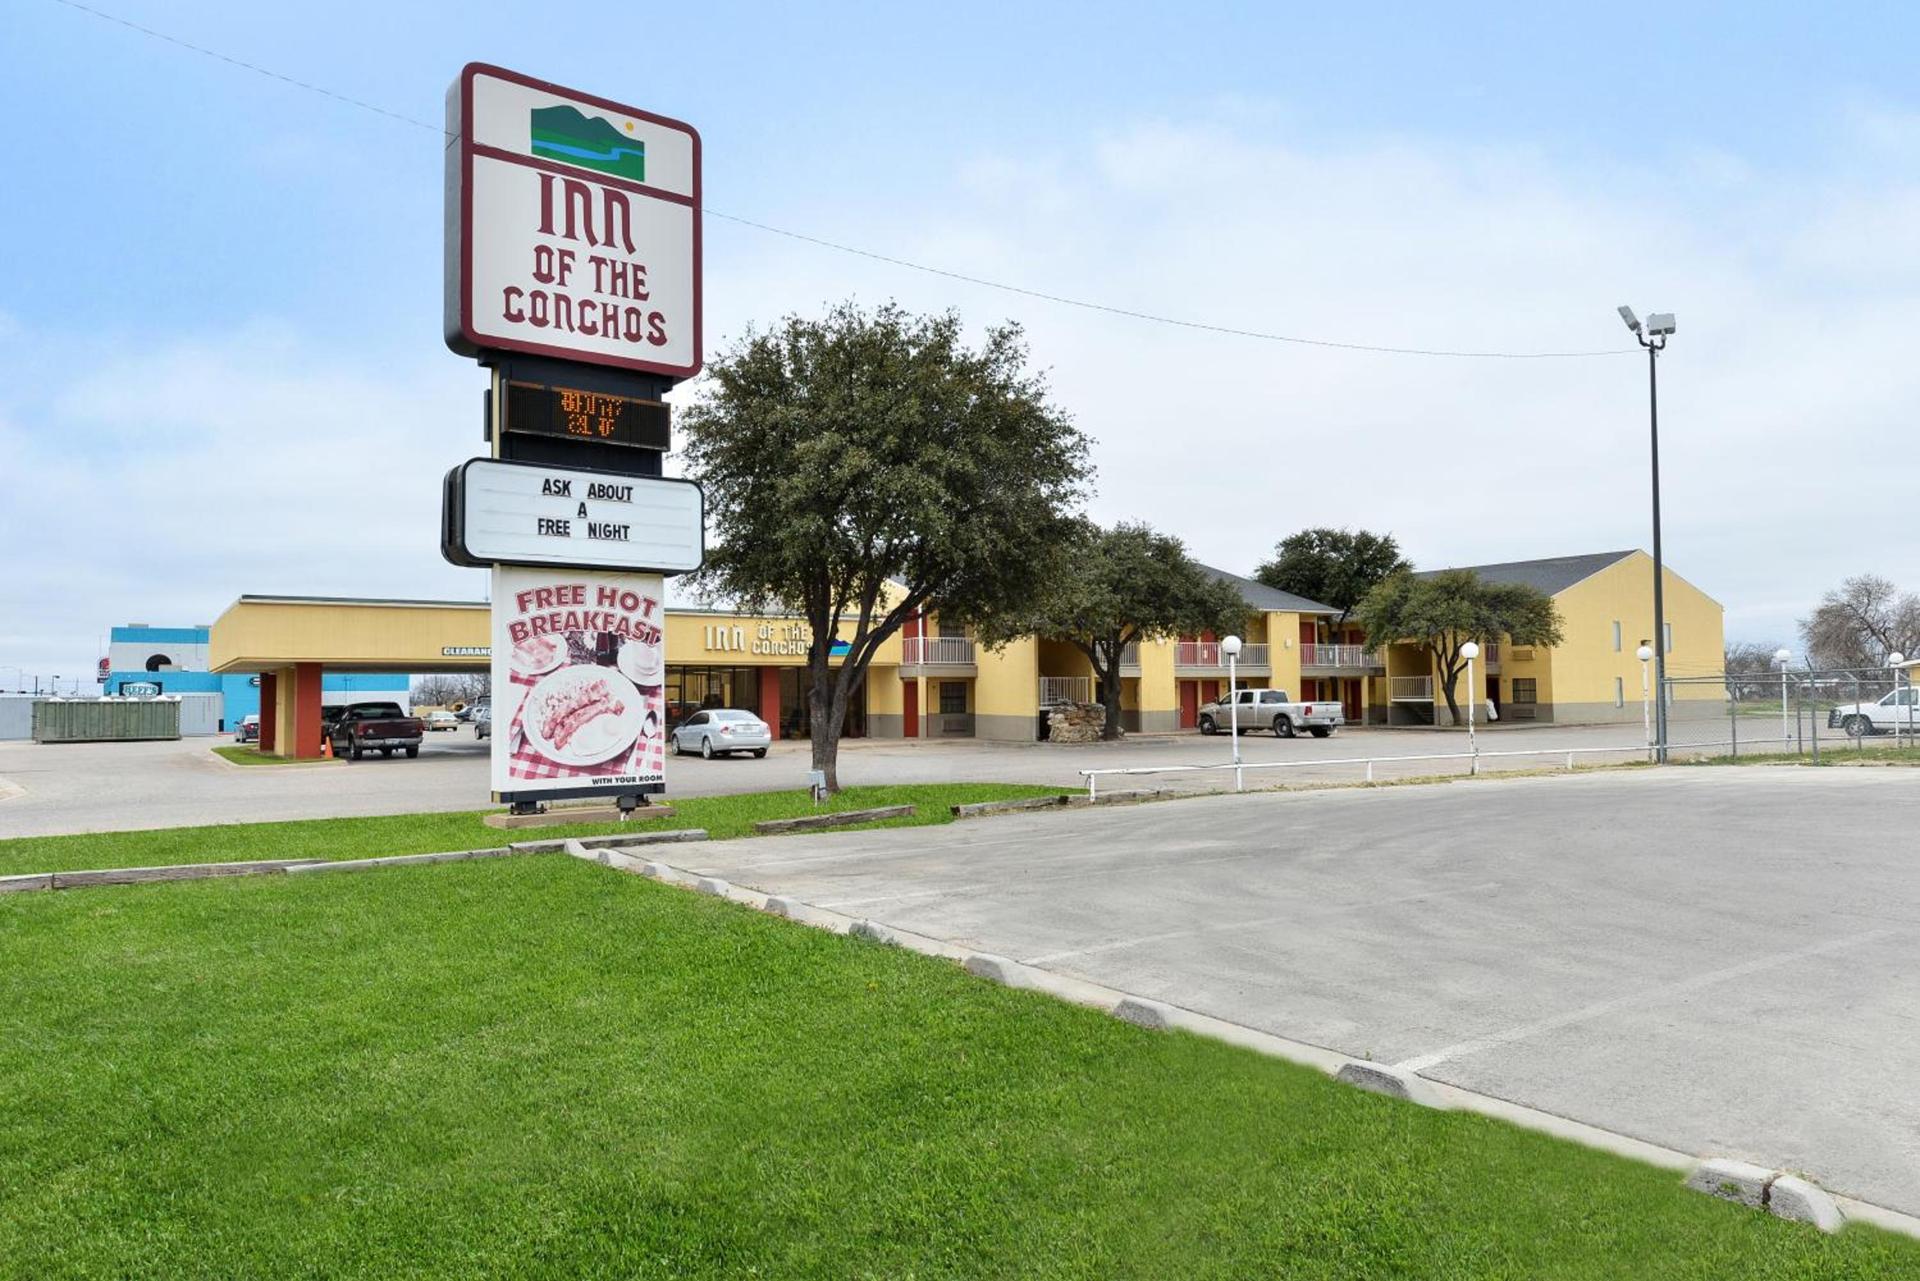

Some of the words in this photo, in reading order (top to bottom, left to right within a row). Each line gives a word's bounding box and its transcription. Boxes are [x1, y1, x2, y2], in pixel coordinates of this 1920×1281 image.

[537, 171, 636, 255] INN
[532, 244, 576, 287] OF
[588, 254, 650, 301] THE
[502, 285, 667, 346] CONCHOS
[542, 478, 572, 496] ASK
[587, 482, 633, 501] ABOUT
[577, 501, 588, 518] A
[537, 518, 570, 536] FREE
[587, 521, 630, 540] NIGHT
[516, 585, 586, 613] FREE
[597, 585, 657, 618] HOT
[508, 610, 663, 645] BREAKFAST
[704, 625, 745, 657] INN
[759, 625, 776, 640] OF
[782, 623, 808, 640] THE
[592, 777, 613, 785] WITH
[614, 776, 637, 784] YOUR
[639, 774, 663, 783] ROOM
